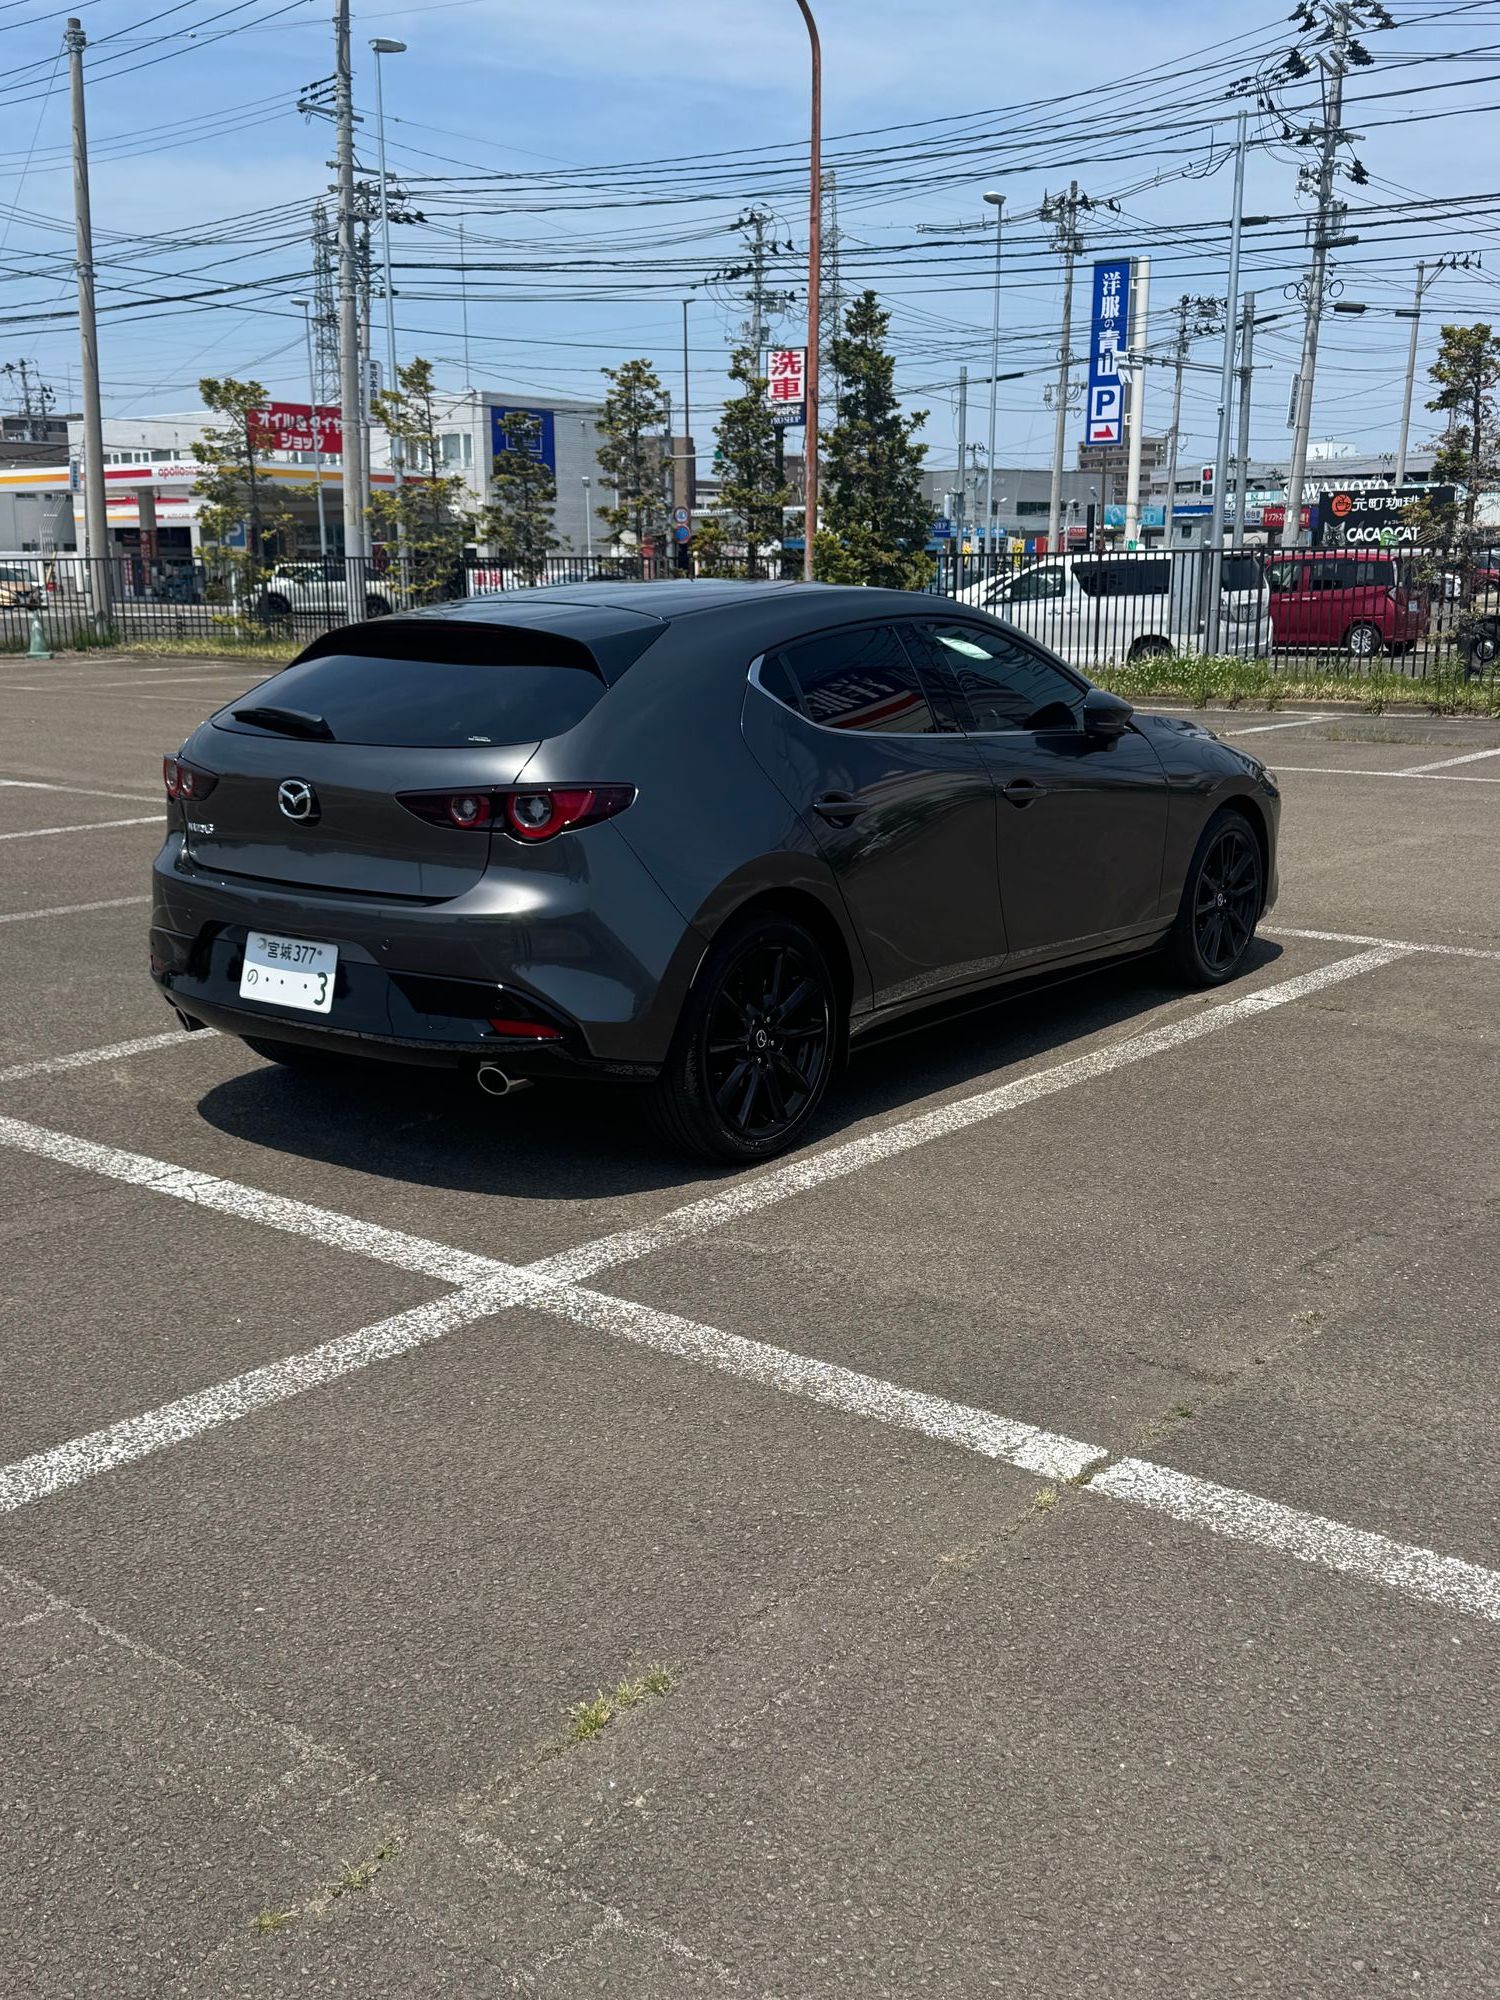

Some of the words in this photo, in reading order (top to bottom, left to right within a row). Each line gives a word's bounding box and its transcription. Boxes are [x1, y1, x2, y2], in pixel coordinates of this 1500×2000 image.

[1097, 272, 1121, 377] 洋服の青山
[770, 351, 802, 400] 洗車
[1095, 390, 1116, 416] P
[280, 432, 325, 450] ショップ
